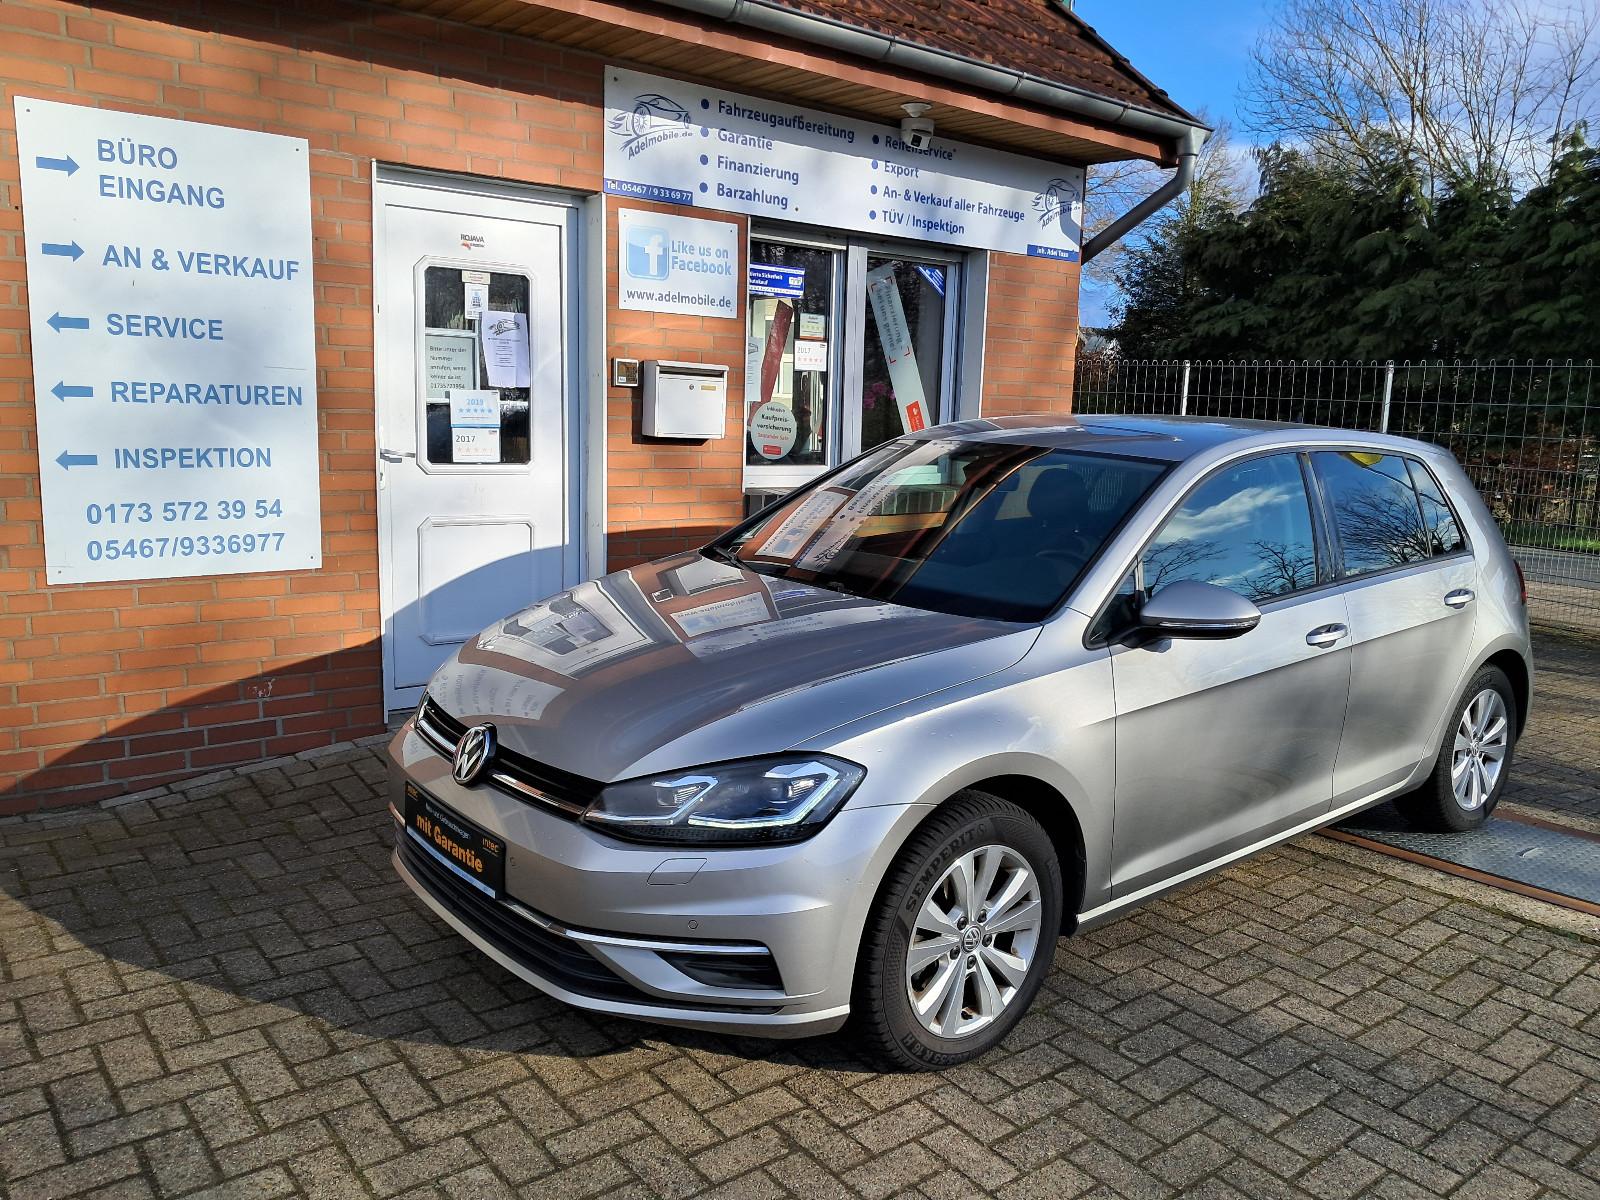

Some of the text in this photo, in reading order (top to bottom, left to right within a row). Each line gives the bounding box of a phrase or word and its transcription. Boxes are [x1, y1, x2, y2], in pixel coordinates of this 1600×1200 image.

[718, 100, 855, 144] Fahrzeugaufbereitung
[628, 129, 693, 160] Adelmobile.de
[717, 128, 773, 150] Garantie
[97, 137, 178, 170] BÜRO
[717, 155, 799, 185] Finanzierung
[884, 160, 919, 179] Export
[99, 174, 226, 209] EINGANG
[606, 180, 621, 191] Tel.
[621, 183, 647, 194] 05467
[681, 192, 692, 201] 77
[717, 183, 788, 209] Barzahlung
[883, 185, 1025, 222] An- & Verkauf aller Fahrzeuge
[882, 208, 904, 224] TÜV
[912, 215, 965, 235] Inspektion
[102, 244, 300, 281] AN & VERKAUF
[671, 240, 729, 259] Like us on
[671, 256, 732, 276] Facebook
[627, 289, 731, 308] www.adelmobile.de
[106, 313, 224, 340] SERVICE
[110, 381, 303, 406] REPARATUREN
[455, 434, 476, 443] 2017
[114, 447, 272, 469] INSPEKTION
[86, 498, 283, 525] 0173 572 39 54
[87, 532, 286, 561] 05467/9336977
[416, 813, 432, 838] mit
[434, 825, 483, 873] Garantie
[905, 826, 976, 912] SEMPERIT
